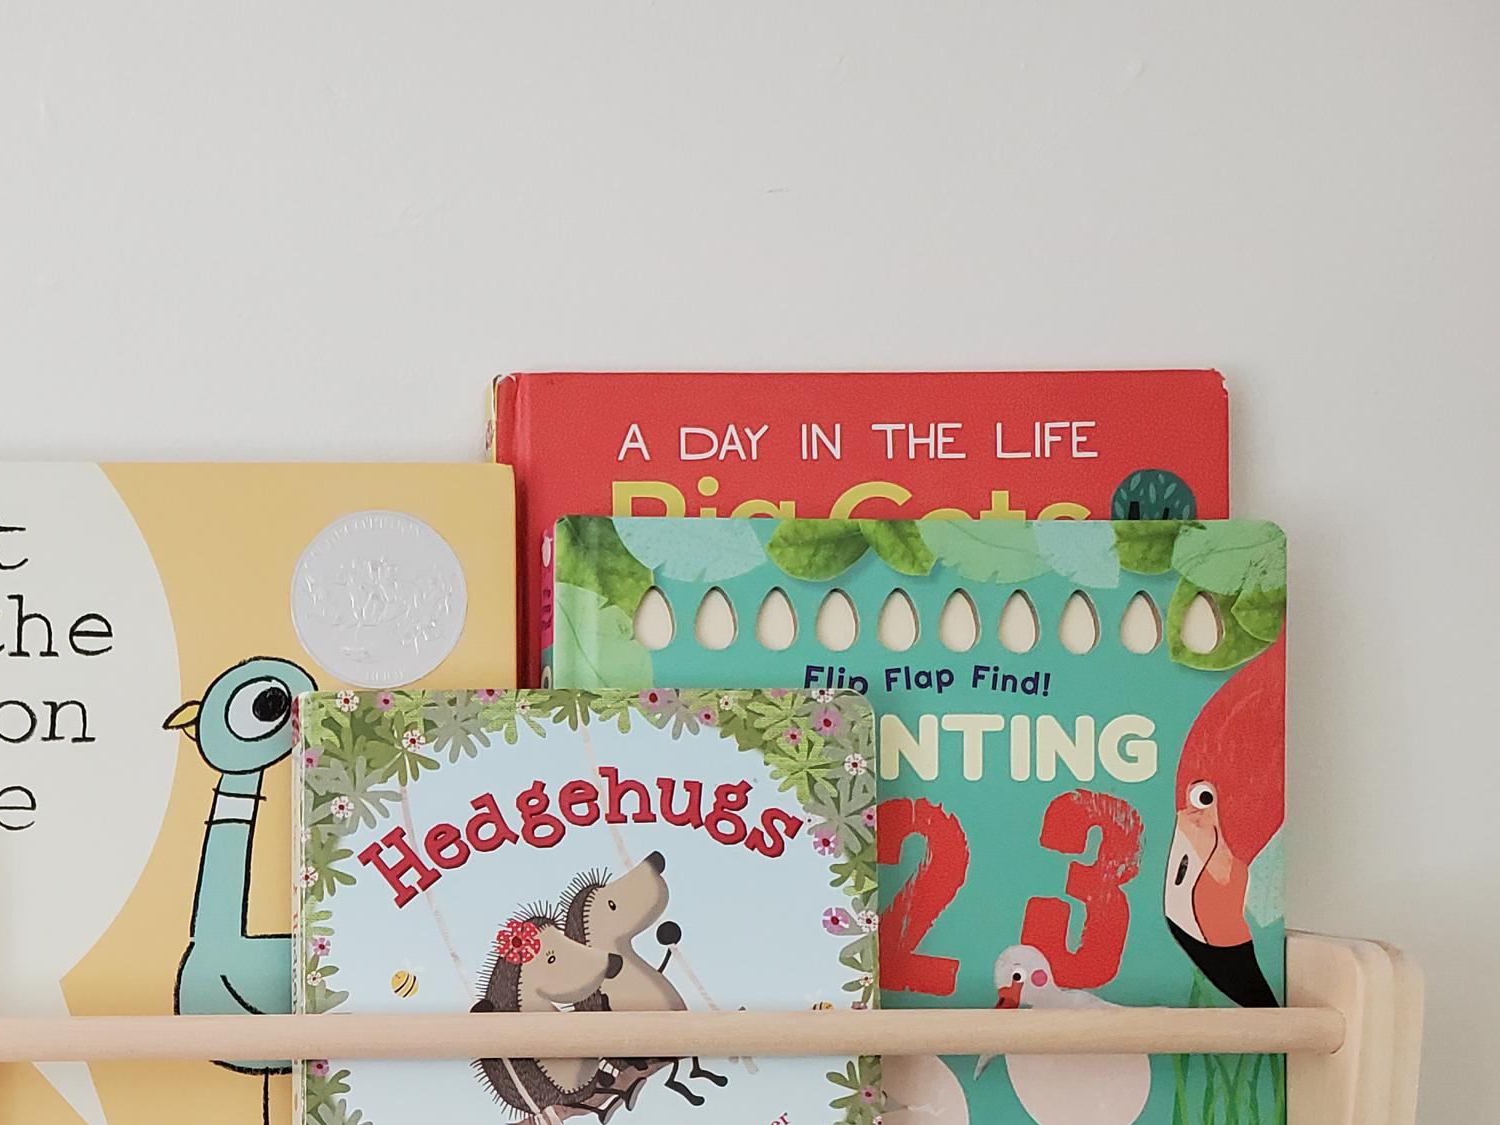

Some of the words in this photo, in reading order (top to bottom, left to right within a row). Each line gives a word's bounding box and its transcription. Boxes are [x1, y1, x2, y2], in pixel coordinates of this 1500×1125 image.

[617, 423, 651, 461] A
[679, 424, 769, 462] DAY
[801, 422, 842, 461] IN
[871, 422, 967, 461] THE
[995, 420, 1100, 459] LIFE
[804, 665, 869, 695] Flip
[884, 665, 955, 694] Flap
[971, 665, 1052, 697] Find!
[879, 713, 1158, 783] NTING
[357, 766, 804, 909] Hedgehugs
[876, 797, 970, 997] 2
[1020, 788, 1145, 990] 3
